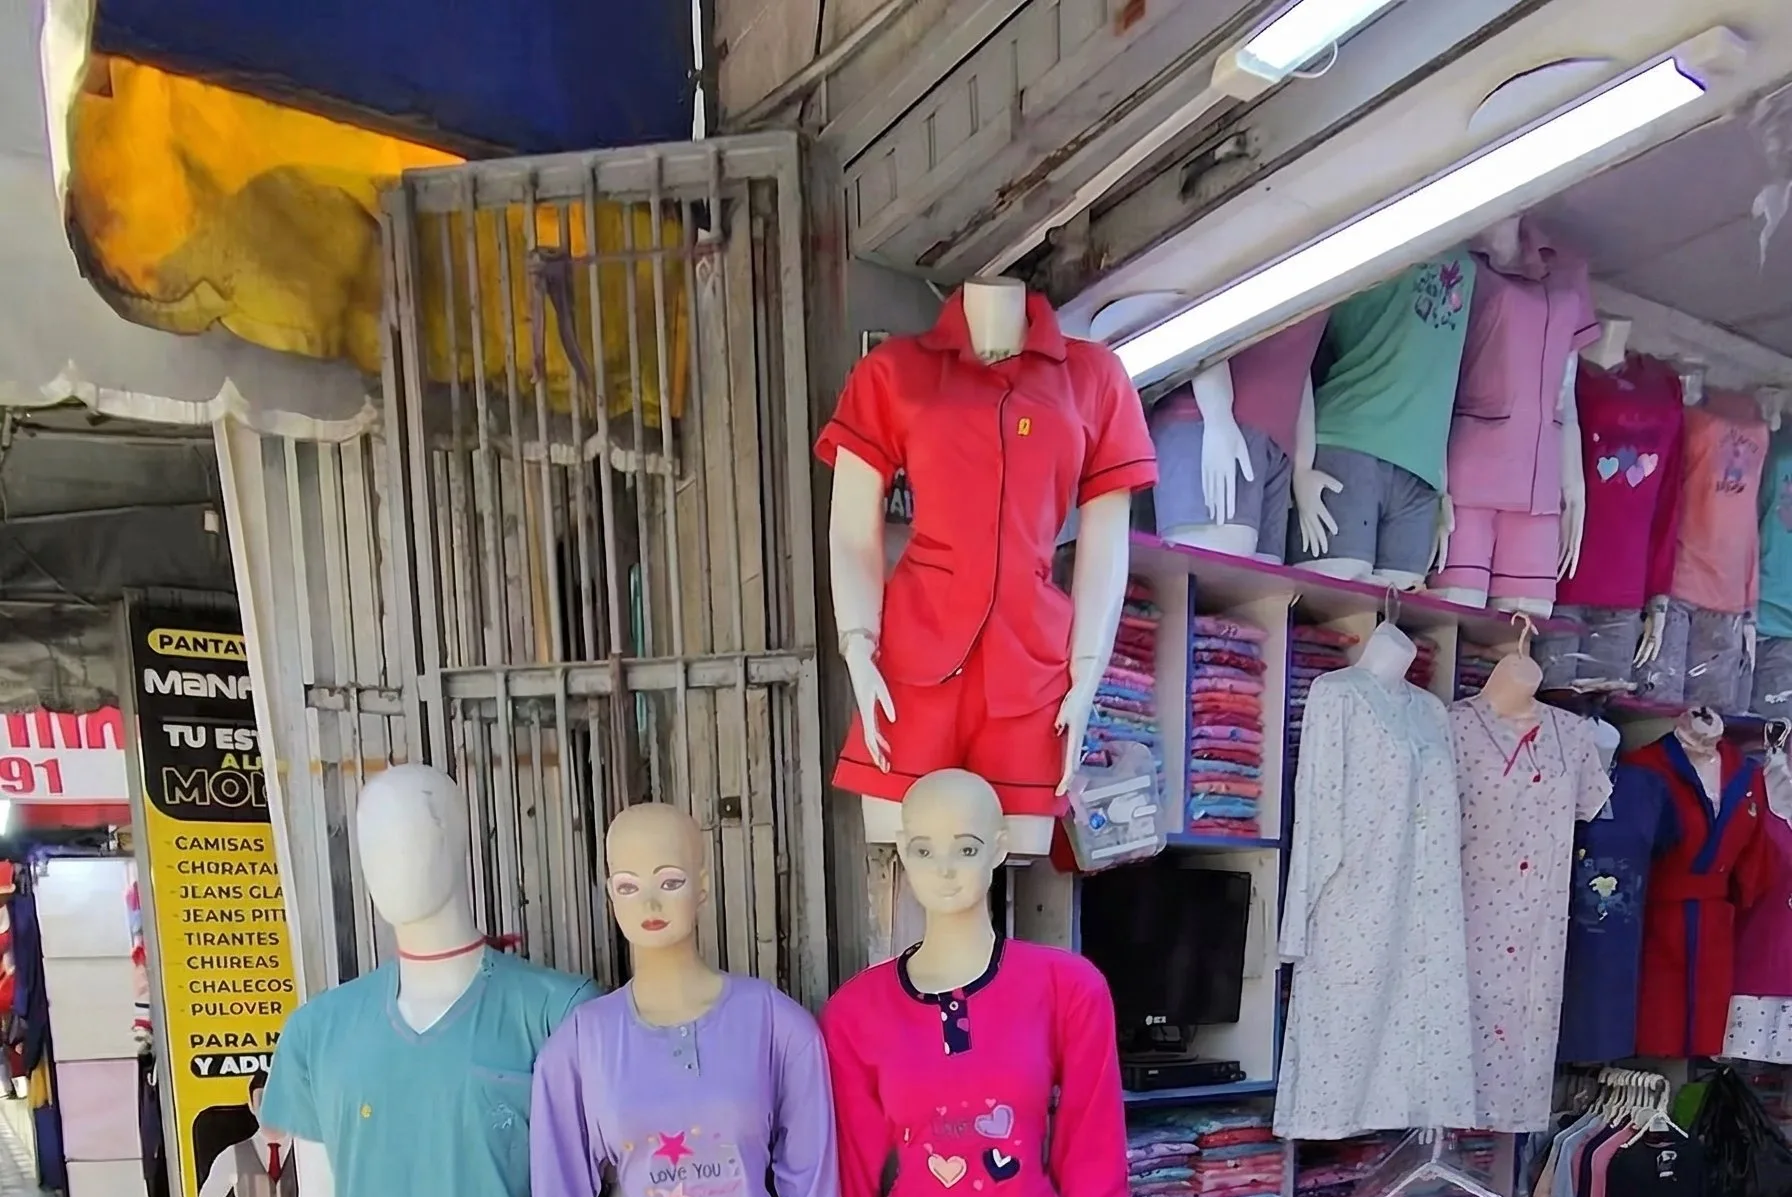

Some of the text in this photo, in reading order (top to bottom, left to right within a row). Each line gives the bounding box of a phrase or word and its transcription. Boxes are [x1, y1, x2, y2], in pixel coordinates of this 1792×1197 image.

[163, 724, 207, 748] TU
[221, 752, 240, 769] A
[0, 756, 63, 794] 91
[175, 836, 265, 852] CAMISAS
[182, 908, 245, 922] JEANS
[184, 932, 280, 946] TIRANTES
[189, 979, 293, 993] CHALECOS
[191, 1001, 282, 1016] PULOVER
[190, 1033, 257, 1048] PARA
[194, 1057, 213, 1075] Y
[692, 1163, 721, 1179] YOU
